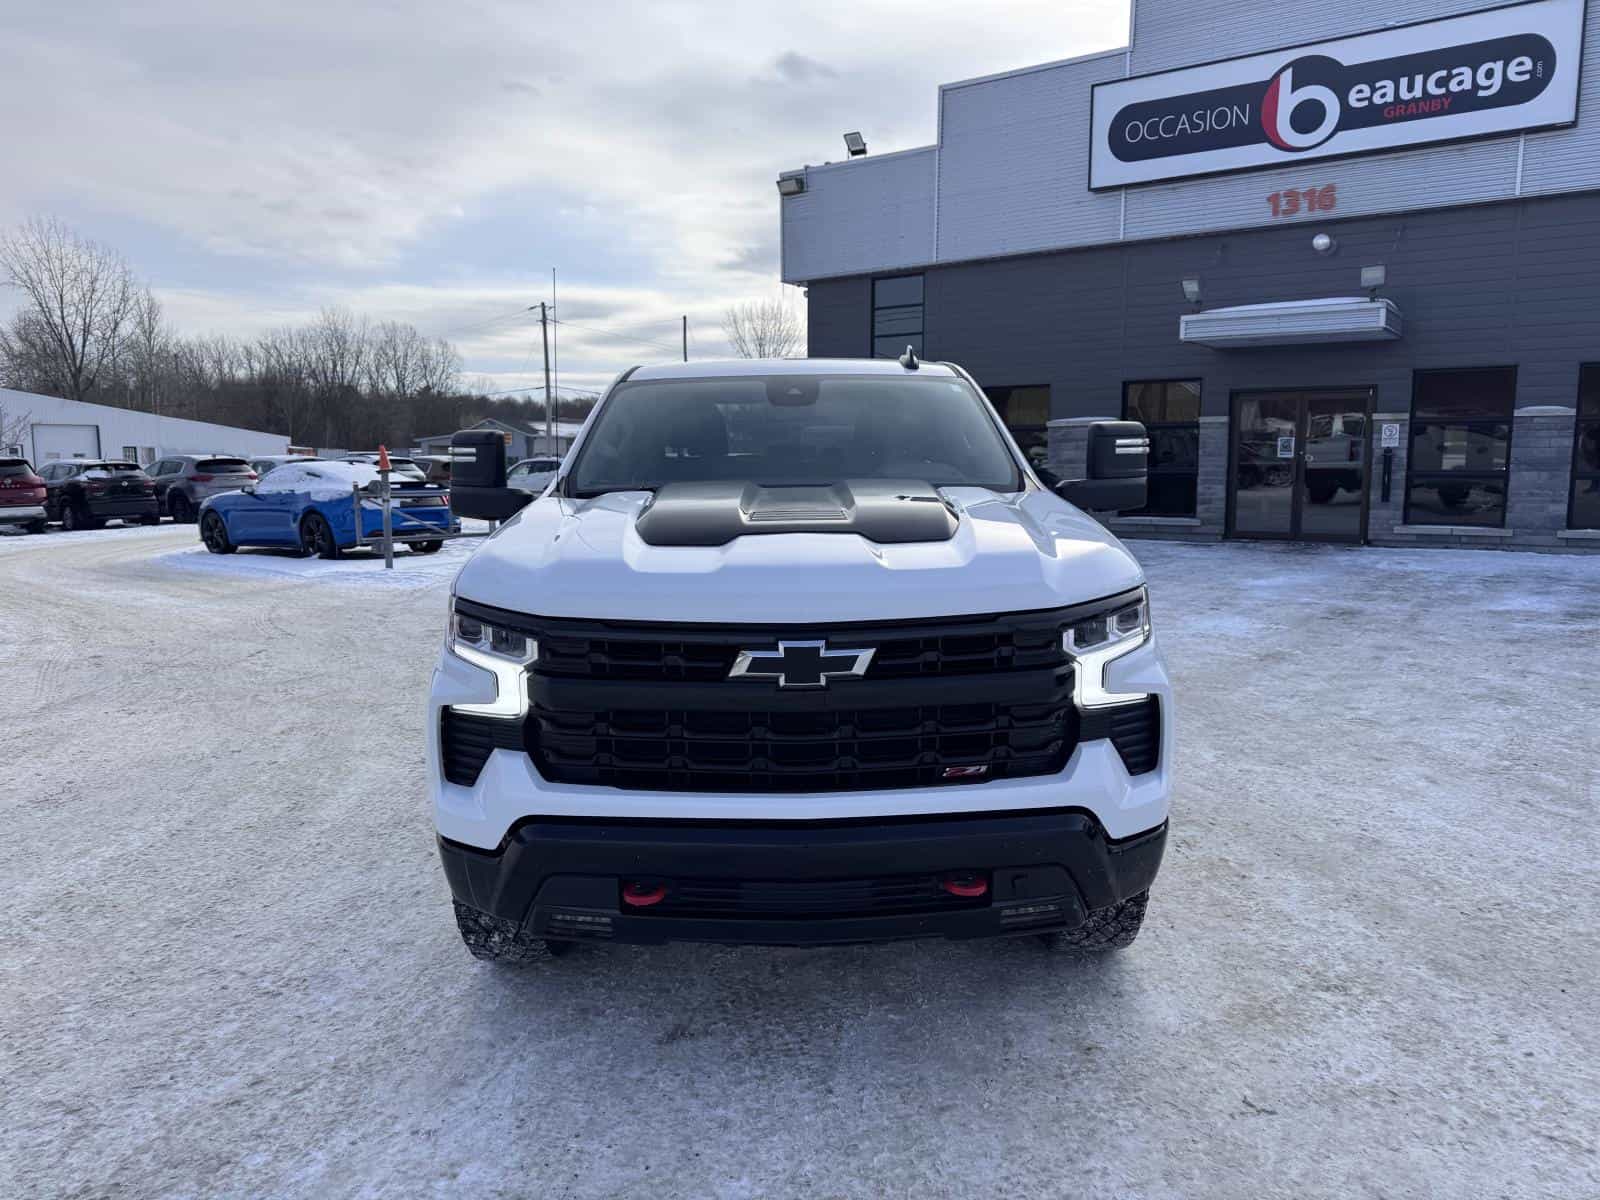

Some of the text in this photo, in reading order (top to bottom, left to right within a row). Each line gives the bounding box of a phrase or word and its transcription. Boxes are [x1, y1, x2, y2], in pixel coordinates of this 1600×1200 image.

[1124, 104, 1250, 143] OCCASION
[1383, 96, 1453, 119] GRANBY
[1266, 184, 1337, 216] 1316
